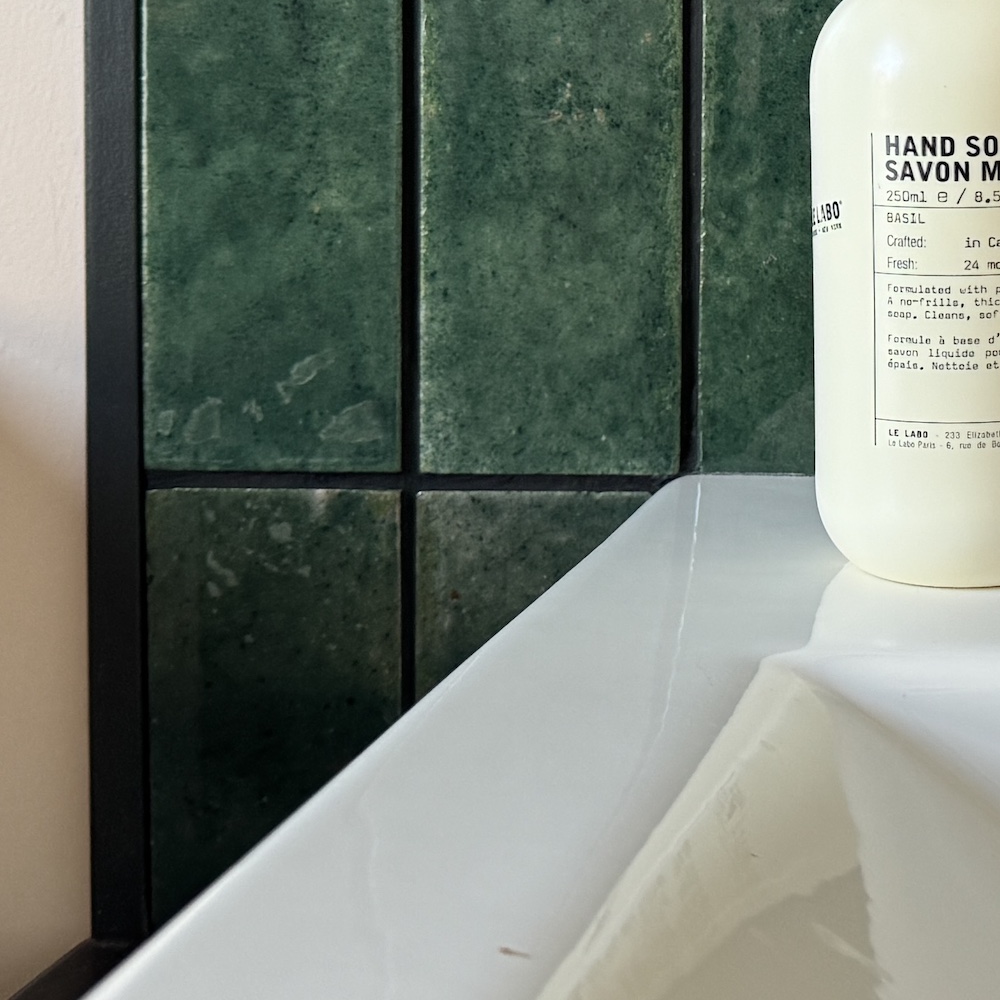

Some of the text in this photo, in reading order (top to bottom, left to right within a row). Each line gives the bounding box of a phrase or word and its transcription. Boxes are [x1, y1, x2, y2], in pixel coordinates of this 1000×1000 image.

[885, 135, 955, 157] HAND
[885, 159, 970, 182] SAVON
[886, 190, 927, 203] 250ml
[956, 188, 967, 204] /
[974, 190, 1000, 203] 8.5
[886, 212, 926, 224] BASIL
[887, 234, 927, 248] Crafted:
[965, 237, 981, 248] in
[887, 256, 918, 270] Fresh:
[964, 260, 979, 271] 24
[887, 283, 951, 294] Formulated
[960, 285, 987, 294] with
[900, 297, 965, 309] no-frills,
[887, 310, 917, 320] soap.
[924, 310, 970, 321] Cleans,
[887, 334, 931, 345] Formule
[953, 336, 981, 345] base
[887, 348, 919, 357] savon
[928, 348, 975, 359] liquide
[932, 361, 979, 371] Nettoie
[986, 361, 999, 370] et
[888, 429, 899, 437] LE
[904, 430, 928, 438] LABO
[945, 431, 961, 439] 233
